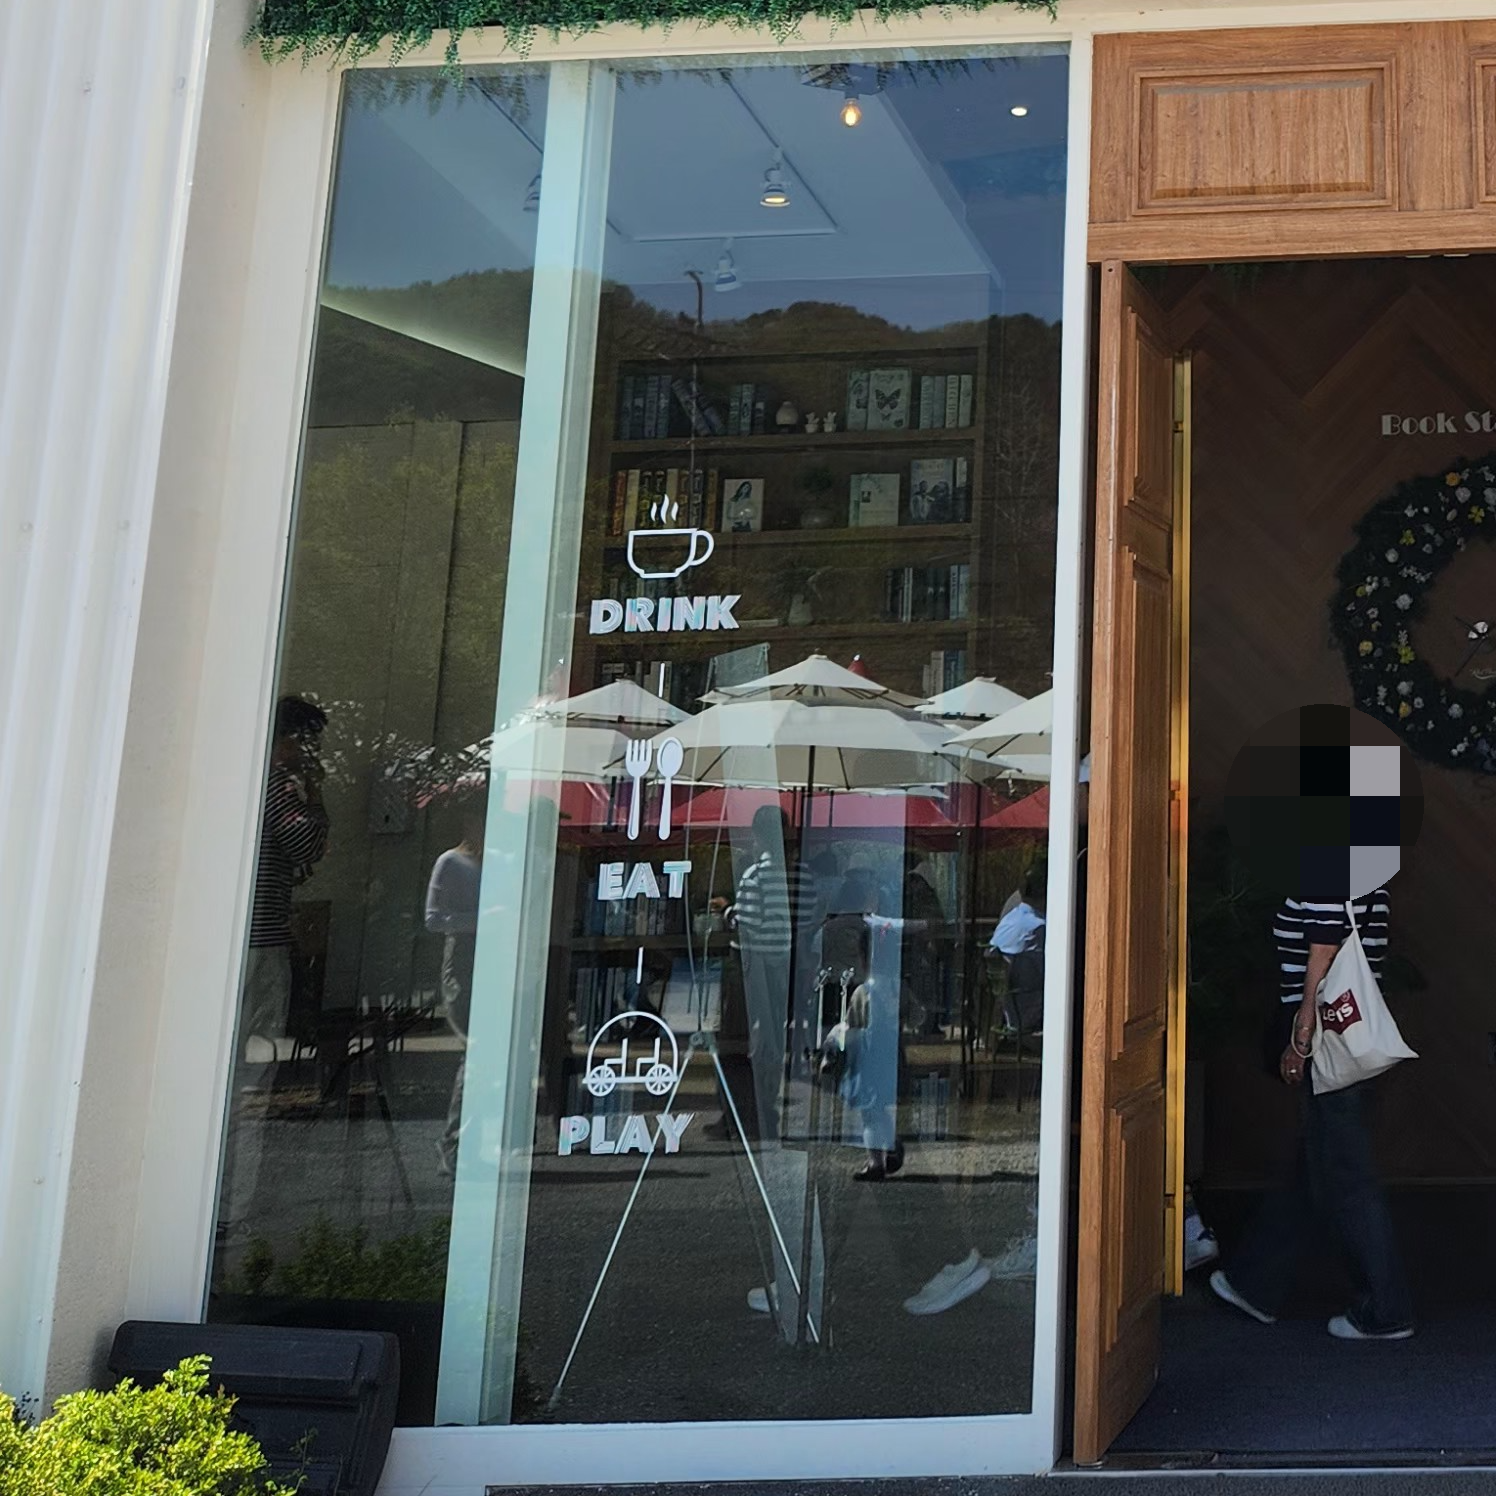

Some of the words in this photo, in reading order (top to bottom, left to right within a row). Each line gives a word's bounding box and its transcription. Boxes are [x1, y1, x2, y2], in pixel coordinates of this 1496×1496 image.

[1381, 412, 1458, 436] Book
[589, 594, 742, 635] DRINK
[597, 860, 692, 900] EAT
[558, 1111, 696, 1156] PLAY
